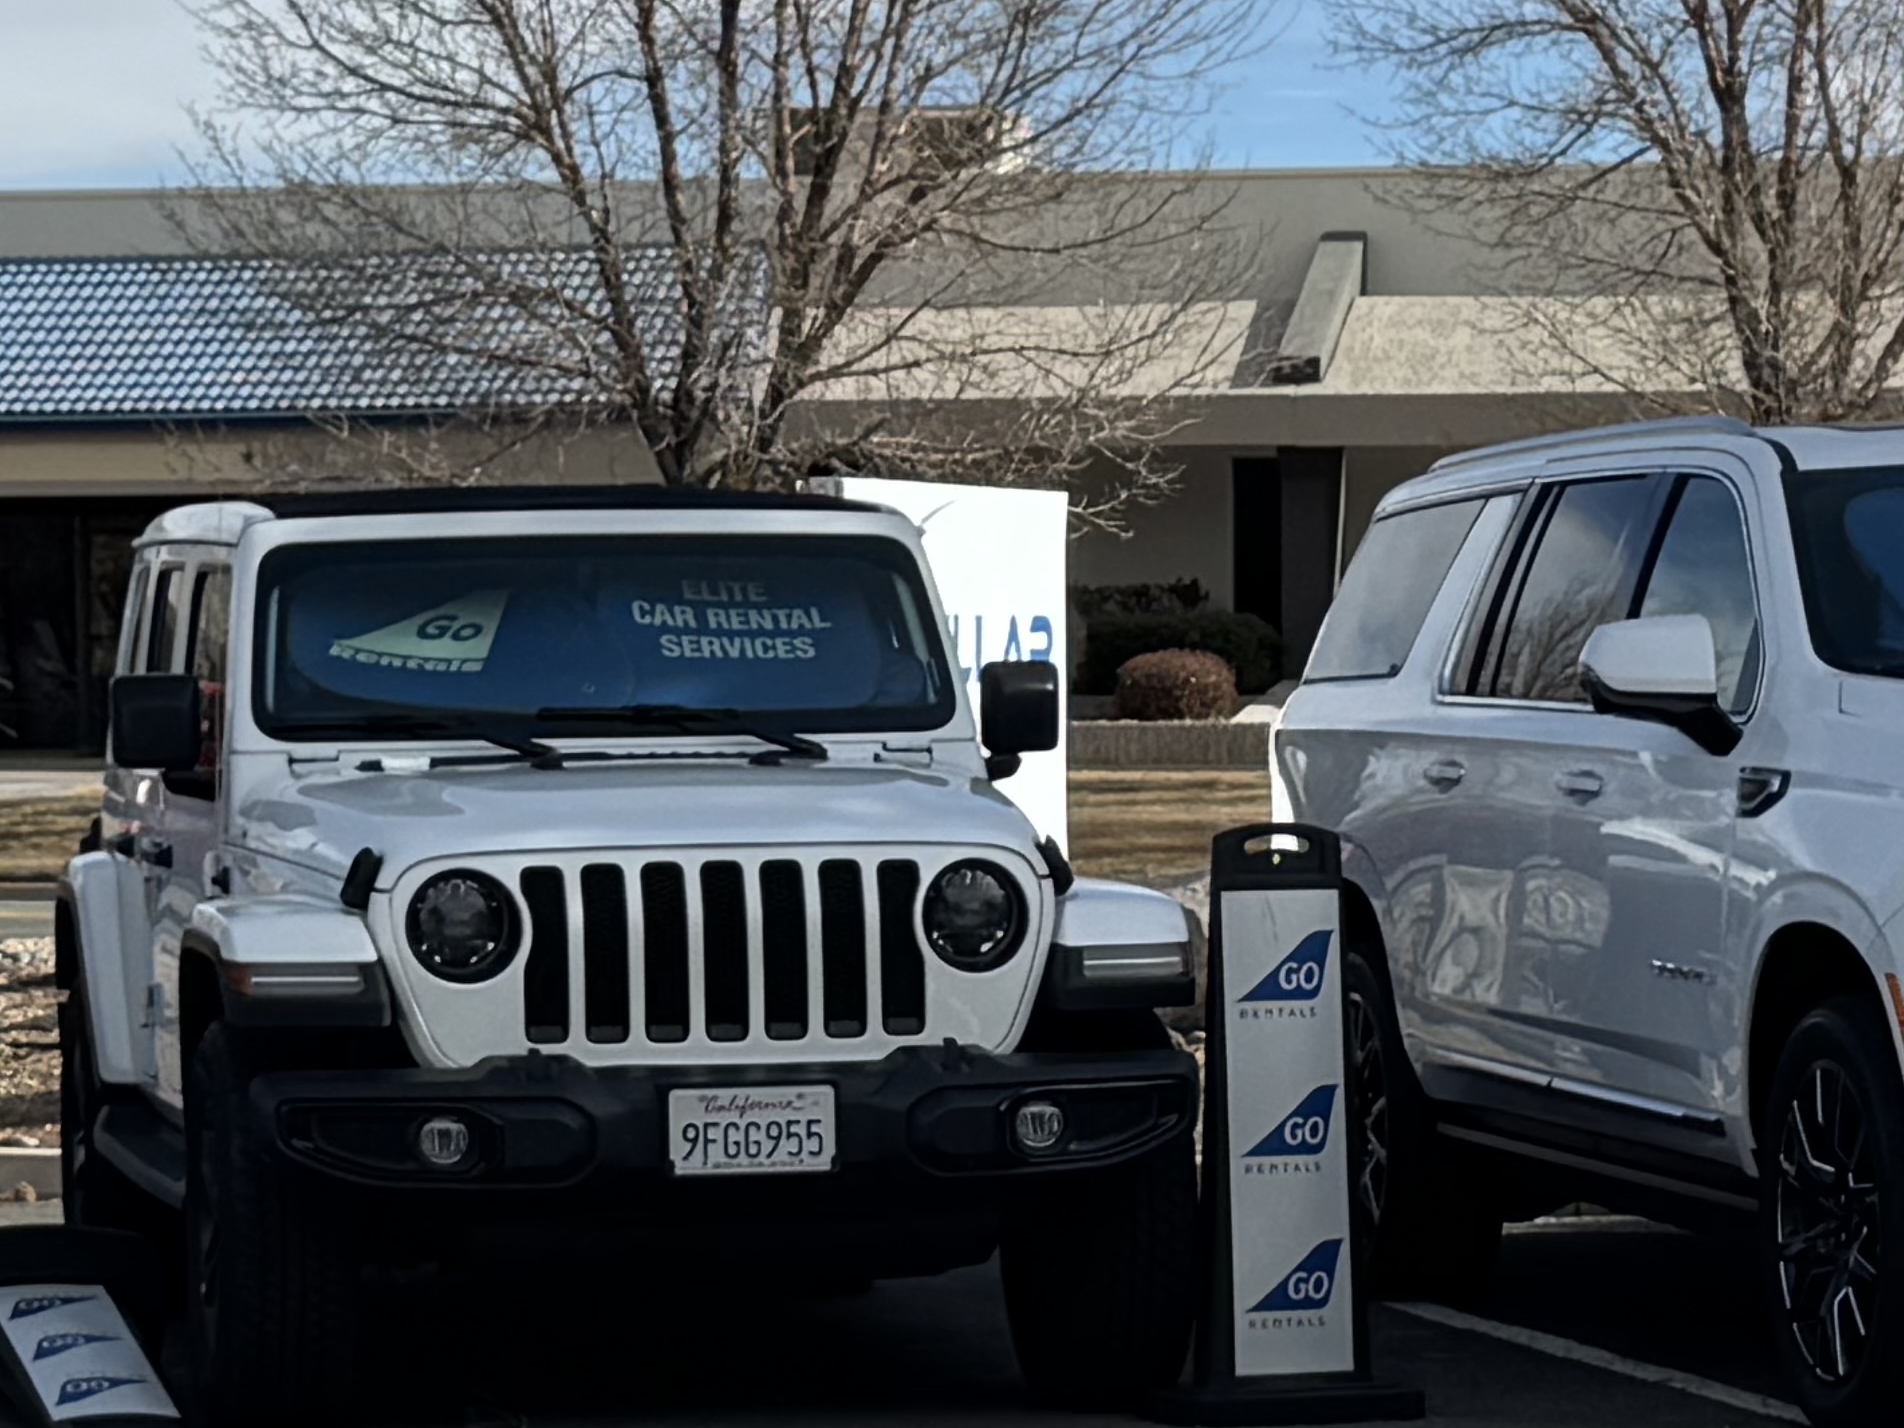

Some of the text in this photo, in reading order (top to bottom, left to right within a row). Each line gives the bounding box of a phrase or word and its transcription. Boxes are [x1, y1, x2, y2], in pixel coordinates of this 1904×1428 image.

[682, 579, 768, 603] ELITE
[631, 600, 833, 630] CAR RENTAL
[659, 634, 816, 659] SERVICES
[1278, 961, 1320, 991] GO
[704, 1094, 804, 1120] California
[681, 1119, 824, 1164] 9FGG955
[1284, 1116, 1325, 1146] GO
[1287, 1271, 1329, 1301] GO
